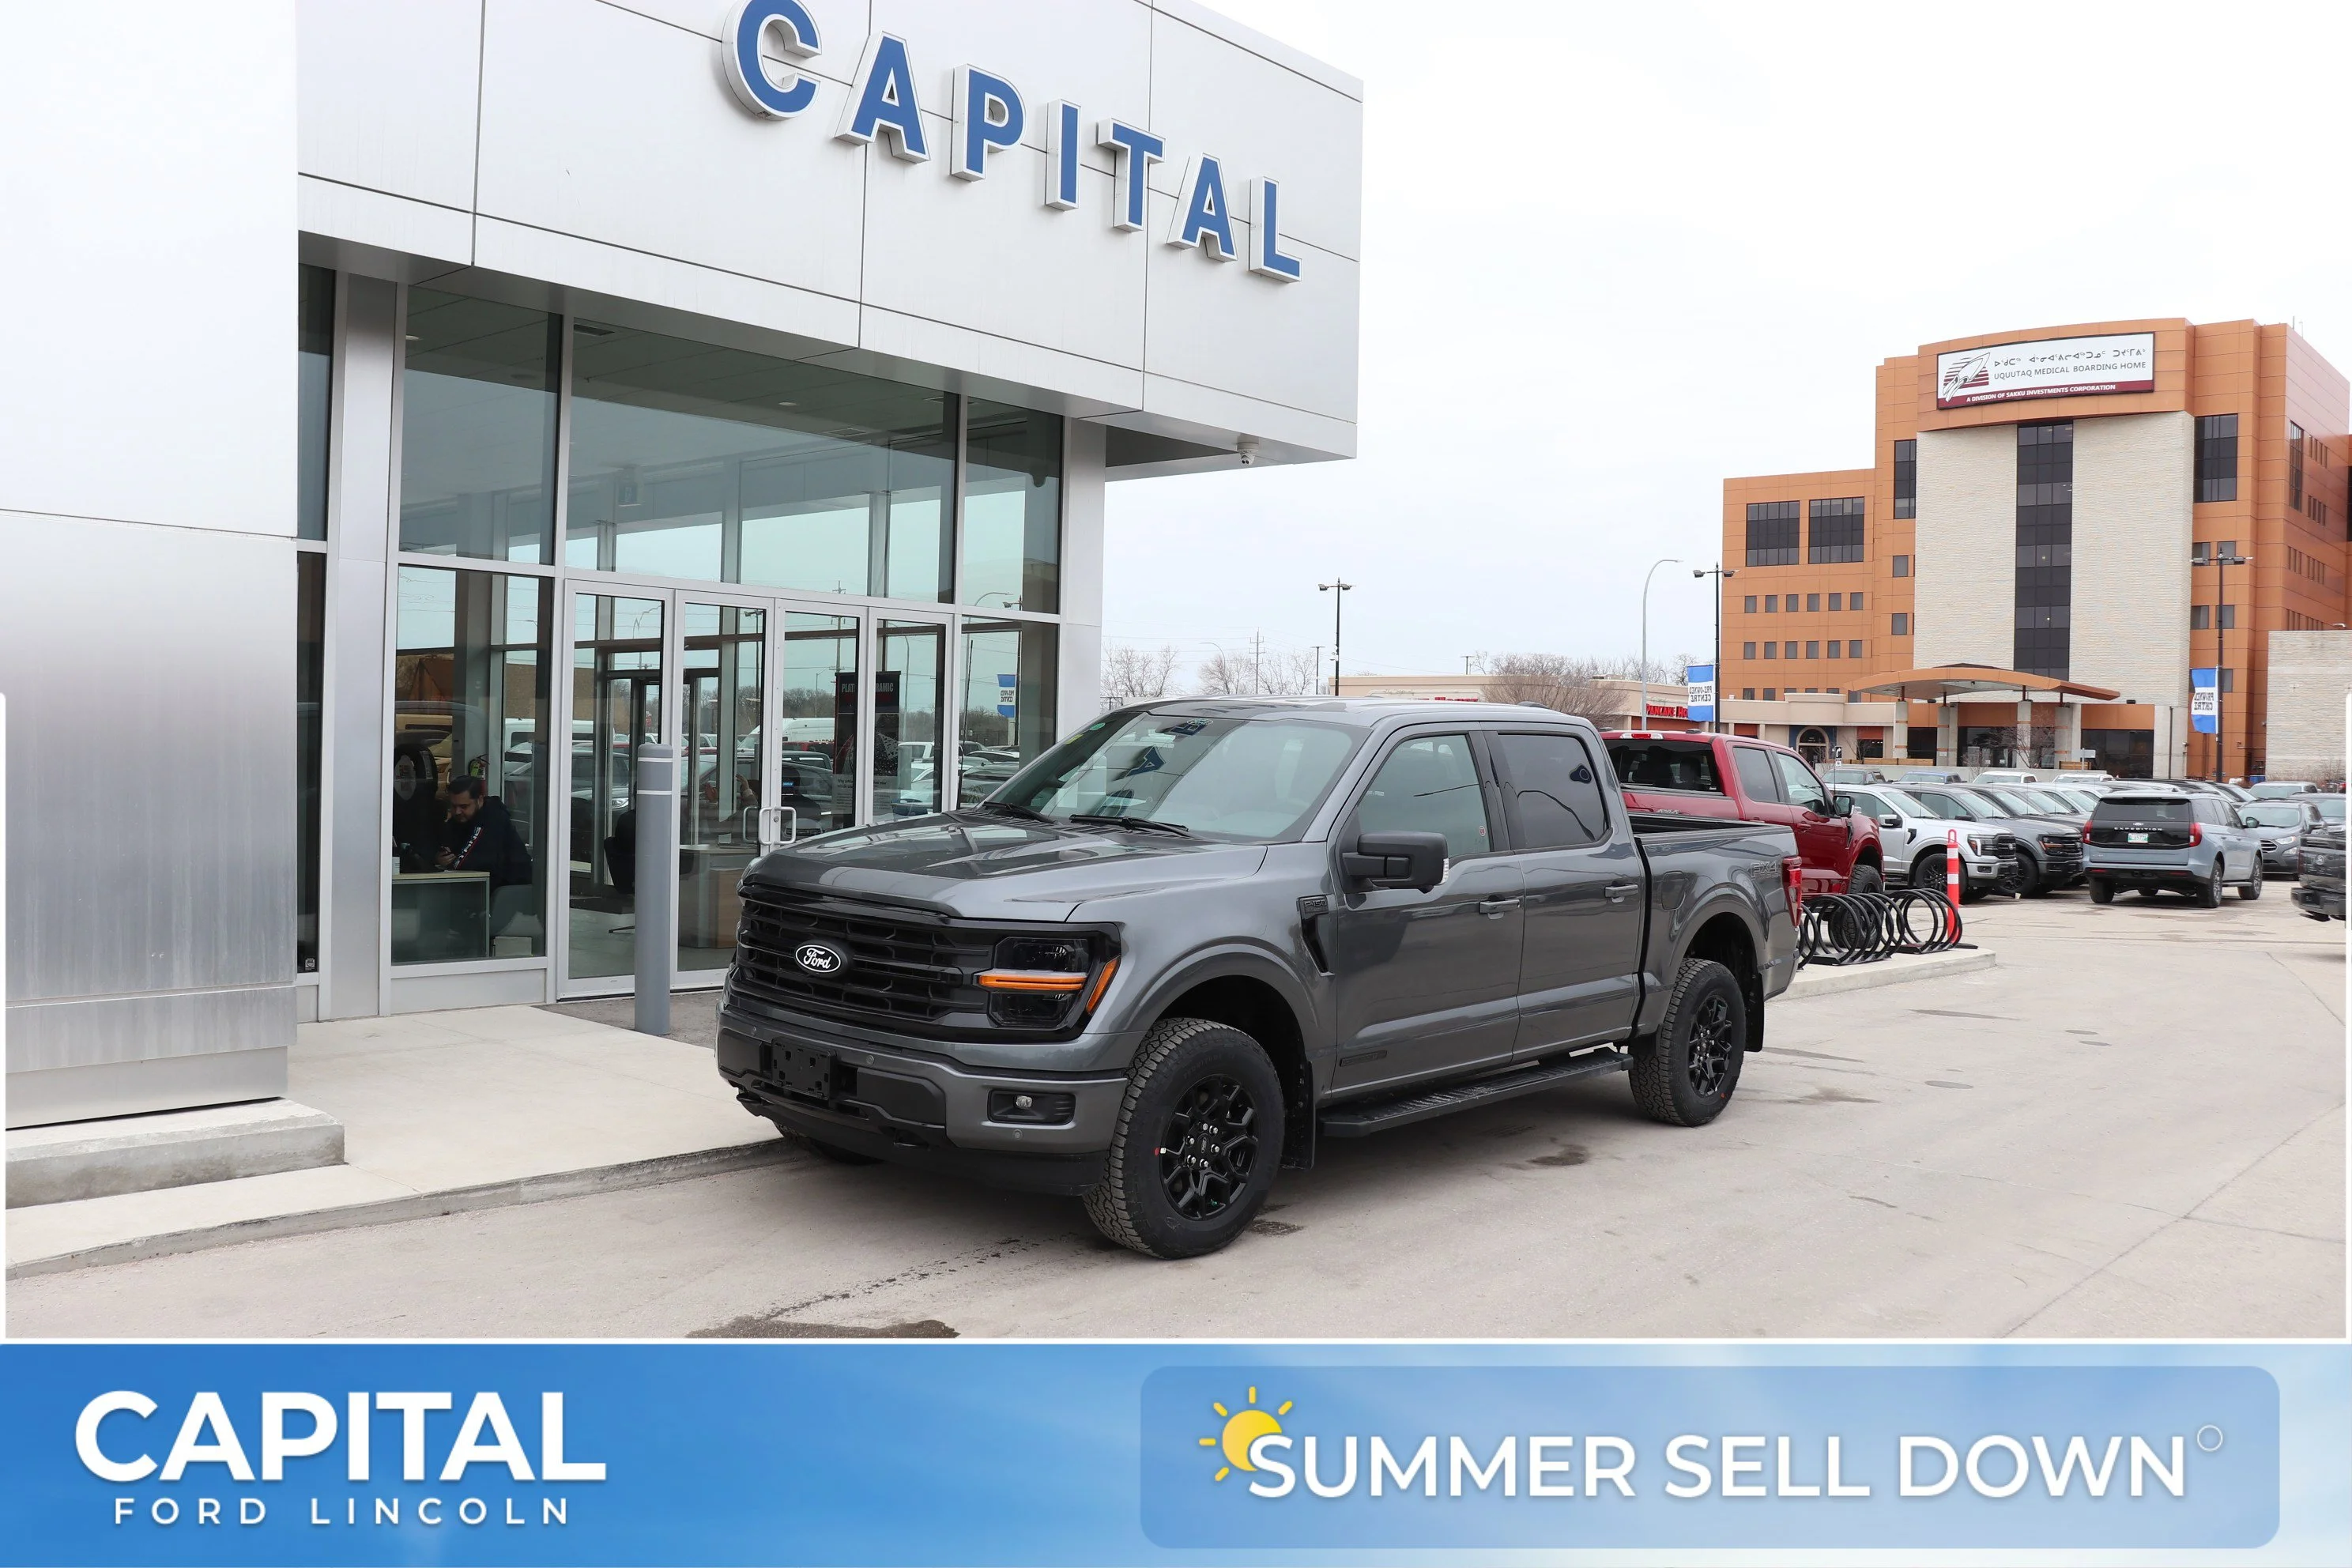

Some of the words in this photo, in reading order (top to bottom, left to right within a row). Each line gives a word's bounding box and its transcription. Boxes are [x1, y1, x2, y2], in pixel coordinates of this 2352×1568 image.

[722, 0, 1302, 283] CAPITAL
[1993, 367, 2033, 379] UQUUTAQ
[2034, 366, 2070, 375] MEDICAL
[2073, 363, 2118, 372] BOARDING
[2026, 386, 2069, 396] INVESTMENTS
[1750, 861, 1780, 879] FX4
[803, 948, 832, 969] Ford
